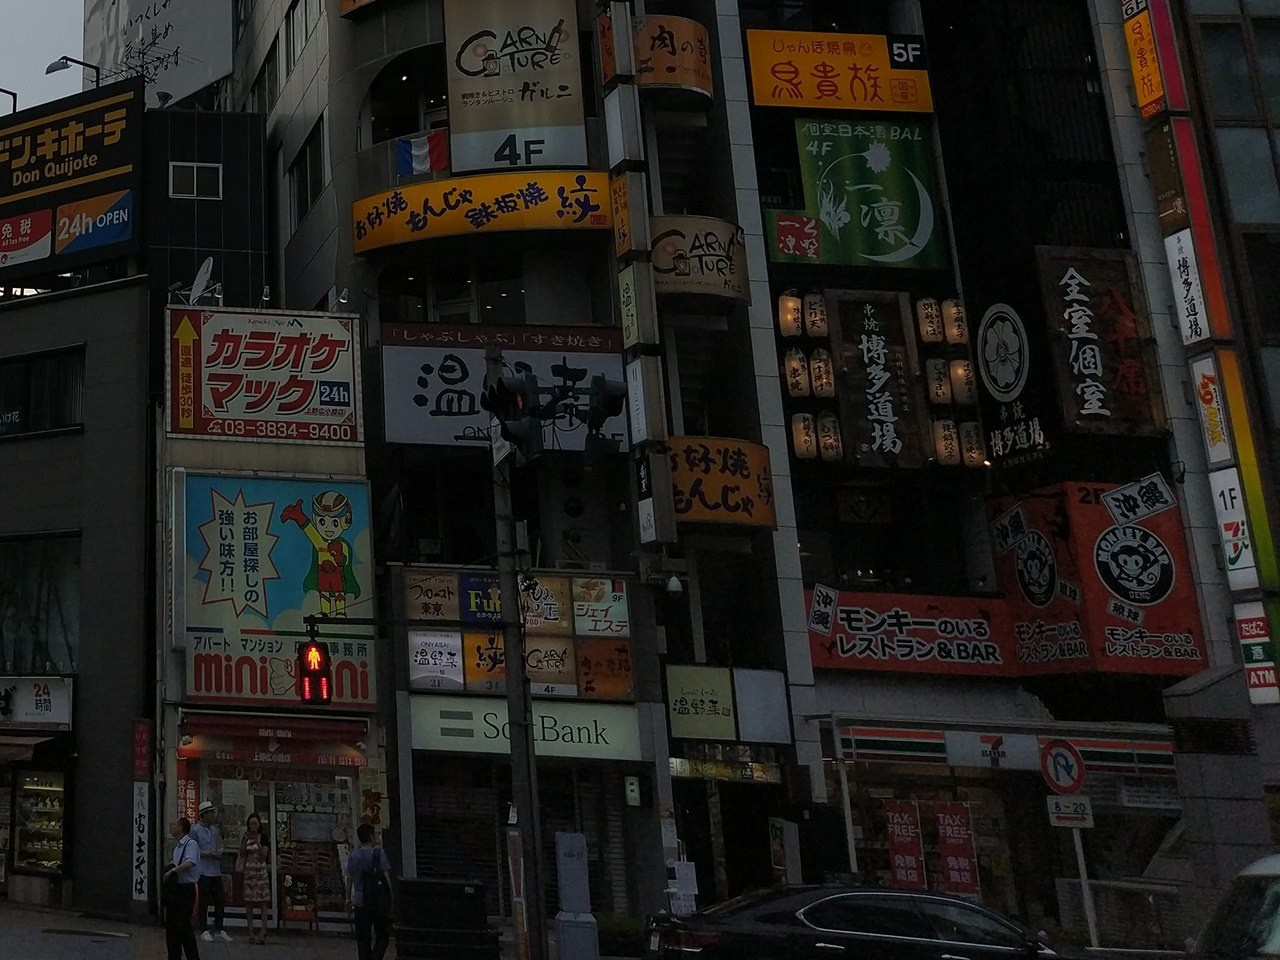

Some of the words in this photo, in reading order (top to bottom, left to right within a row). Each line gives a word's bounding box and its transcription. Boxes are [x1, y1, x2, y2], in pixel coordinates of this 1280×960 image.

[892, 42, 922, 64] 5F
[770, 60, 885, 104] 鳥貴族
[889, 125, 923, 142] BAL
[494, 134, 546, 167] 4F
[804, 141, 833, 157] 4F
[12, 170, 40, 188] Don
[43, 152, 99, 179] Quijote
[356, 191, 409, 240] お好焼
[406, 186, 474, 233] もんじゃ
[464, 182, 550, 228] 鉄板焼
[0, 217, 33, 239] 免税
[58, 212, 94, 241] 24h
[96, 208, 129, 228] OPEN
[1176, 256, 1203, 339] 博多道場
[204, 328, 351, 373] カラオケ
[1058, 267, 1112, 417] 全室個室
[205, 372, 320, 416] マック
[320, 386, 351, 404] 24h
[858, 333, 904, 456] 博多道場
[224, 420, 351, 440] 03-3834-9400
[1114, 480, 1170, 520] 沖縄
[1218, 489, 1238, 512] 1F
[218, 509, 236, 593] 強い味方!!
[1096, 525, 1147, 563] MONKEY
[242, 510, 260, 604] お部屋探しの
[421, 602, 445, 617] 東京
[612, 595, 624, 603] 9F
[576, 604, 614, 617] ジェイ
[588, 619, 628, 632] エステ
[838, 607, 991, 639] モンキーのいる
[193, 637, 231, 652] アパート
[241, 638, 284, 653] マンション
[1105, 626, 1194, 646] モンキーのいる
[1251, 644, 1265, 660] 酒
[194, 653, 268, 693] mini
[1248, 668, 1277, 686] ATM
[33, 683, 51, 698] 24
[544, 685, 557, 695] 4F
[34, 699, 52, 713] 時間
[483, 711, 611, 746] SoBank
[888, 824, 917, 838] FREE
[938, 825, 969, 839] FREE
